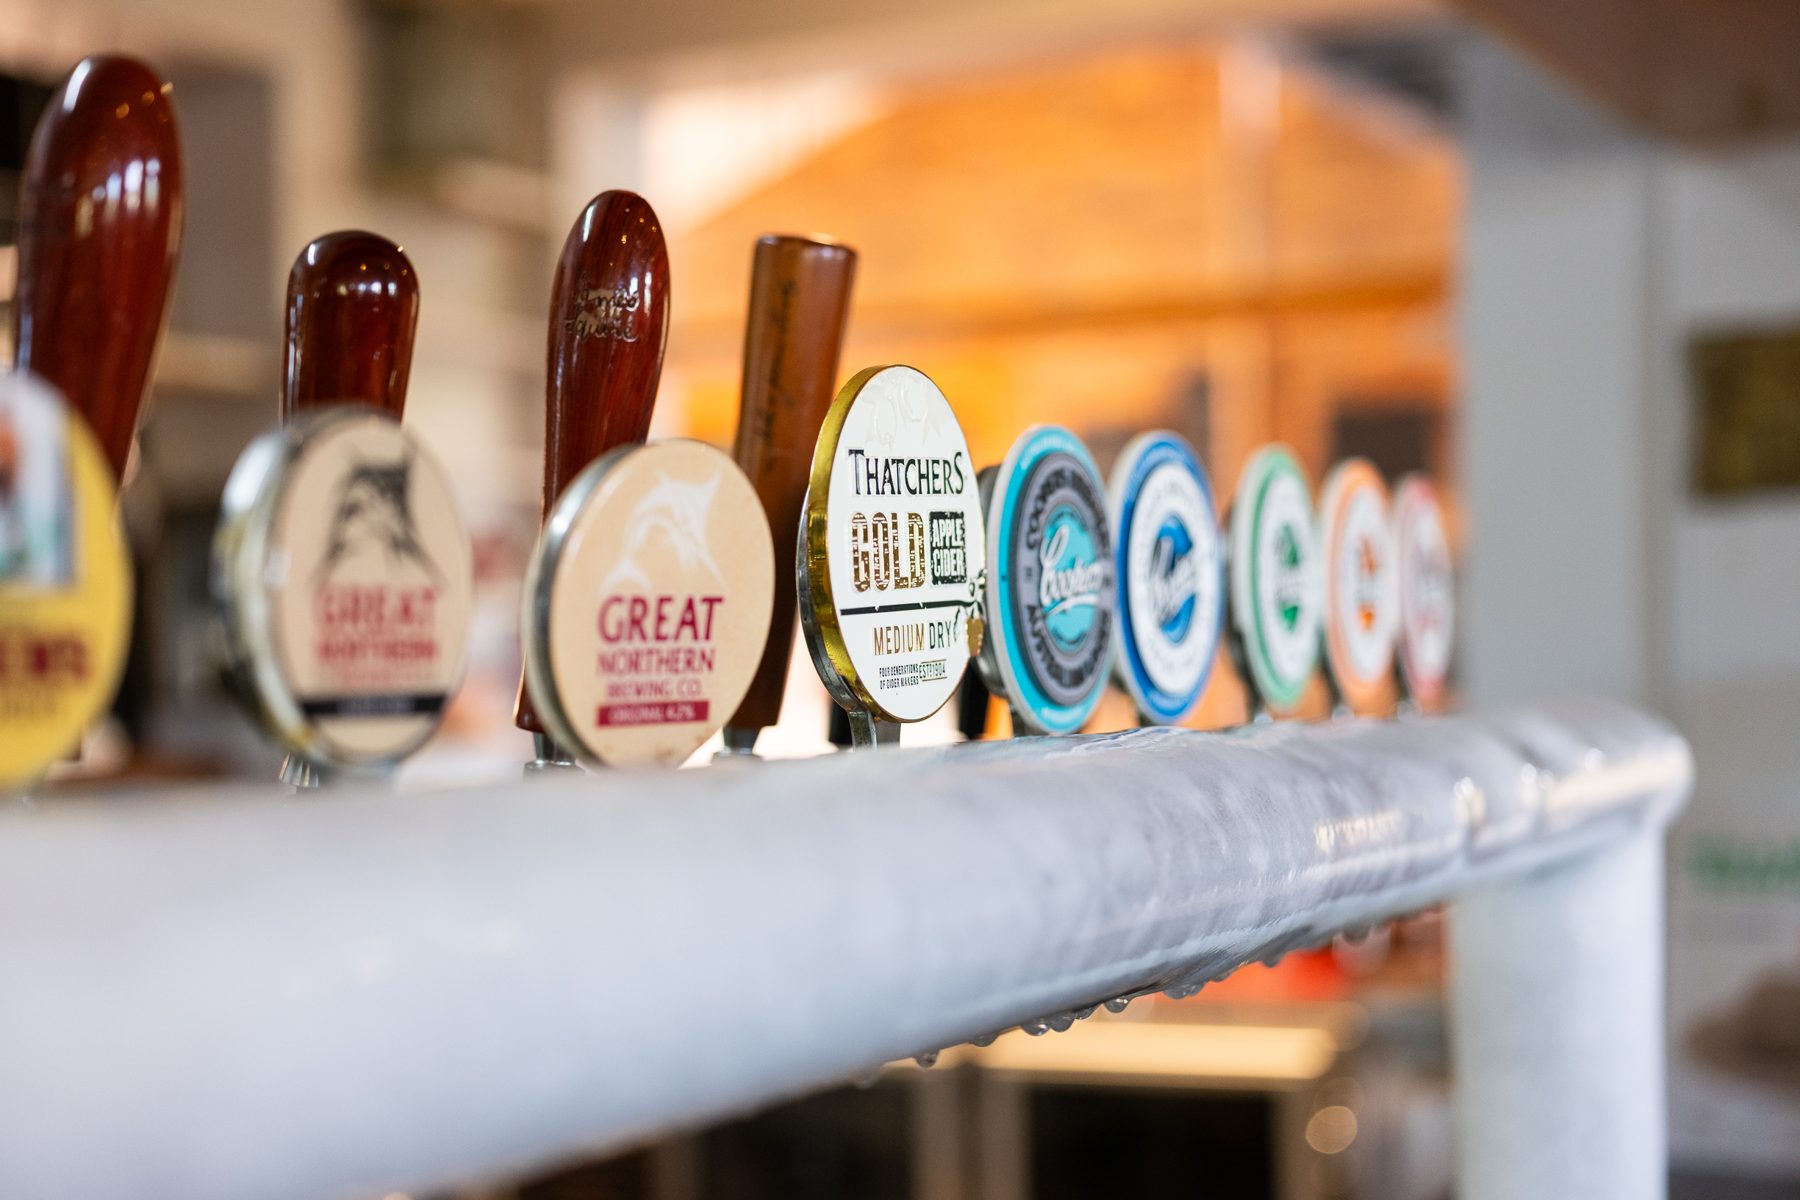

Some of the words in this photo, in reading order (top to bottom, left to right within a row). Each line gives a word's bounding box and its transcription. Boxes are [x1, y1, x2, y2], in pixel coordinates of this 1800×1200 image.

[931, 518, 965, 549] APPLE
[851, 511, 926, 593] GOLD
[931, 548, 967, 578] CIDER
[597, 595, 725, 645] GREAT
[873, 622, 926, 657] MEDIUM
[928, 620, 952, 650] DRY
[597, 646, 717, 677] NORTHERN
[879, 666, 891, 678] FOUR
[890, 663, 919, 677] GENERATIONS
[879, 679, 886, 690] OF
[886, 677, 900, 689] CIDER
[900, 675, 919, 688] MAKERS
